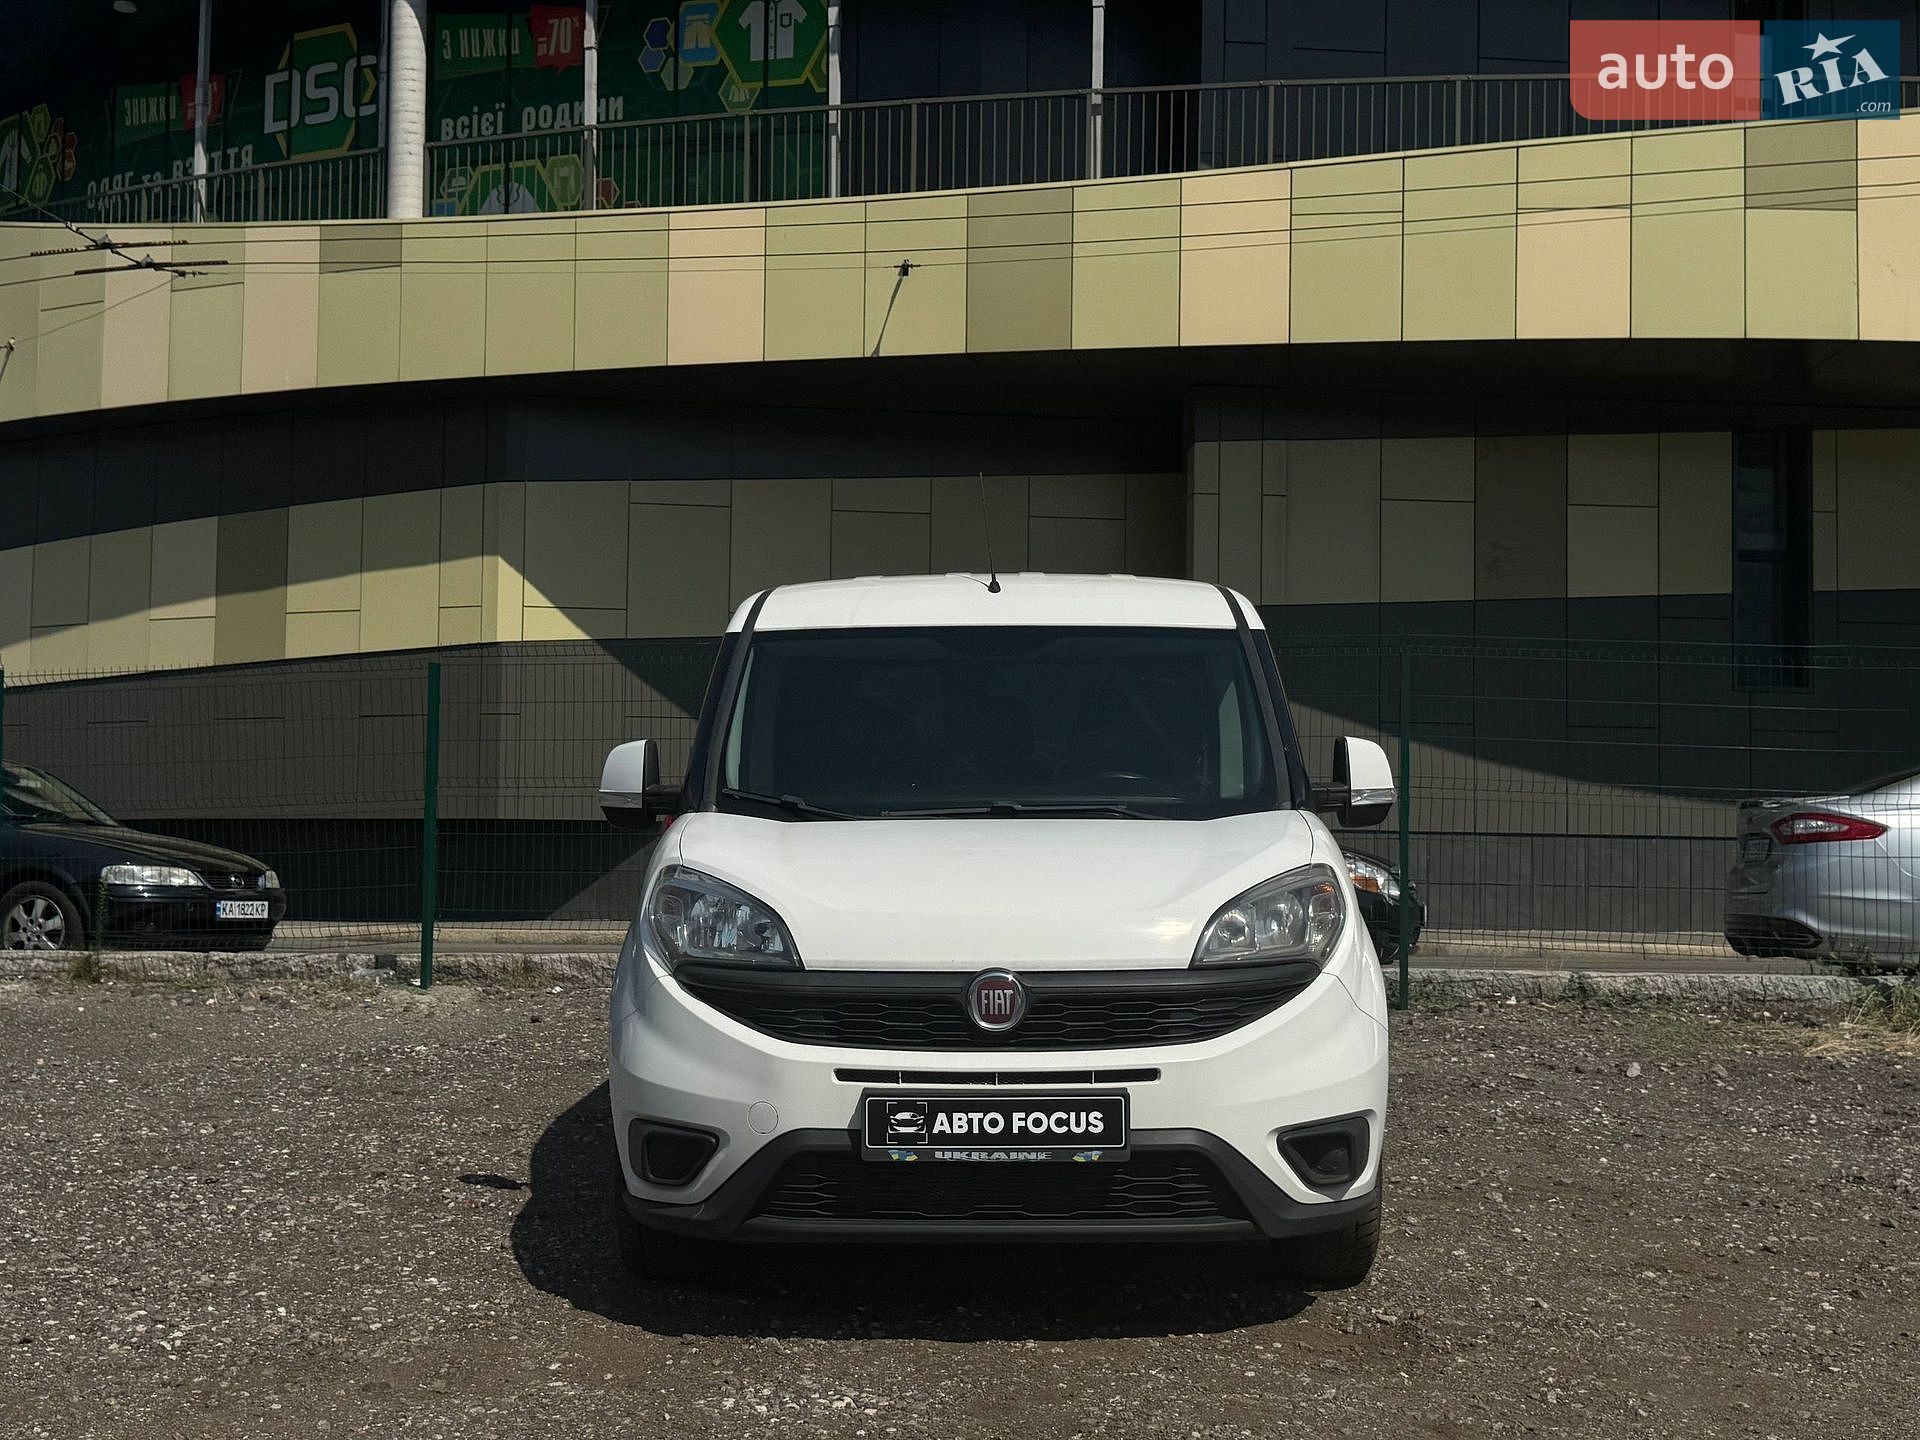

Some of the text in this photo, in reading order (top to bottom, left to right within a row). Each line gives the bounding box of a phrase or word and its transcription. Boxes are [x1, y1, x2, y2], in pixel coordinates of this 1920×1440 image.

[442, 28, 521, 60] ЗНИЖКИ
[440, 102, 506, 142] всієї
[981, 989, 1014, 1015] FIAT
[932, 1111, 1104, 1134] АВТО FOCUS
[935, 1151, 1053, 1162] UKRAINE
